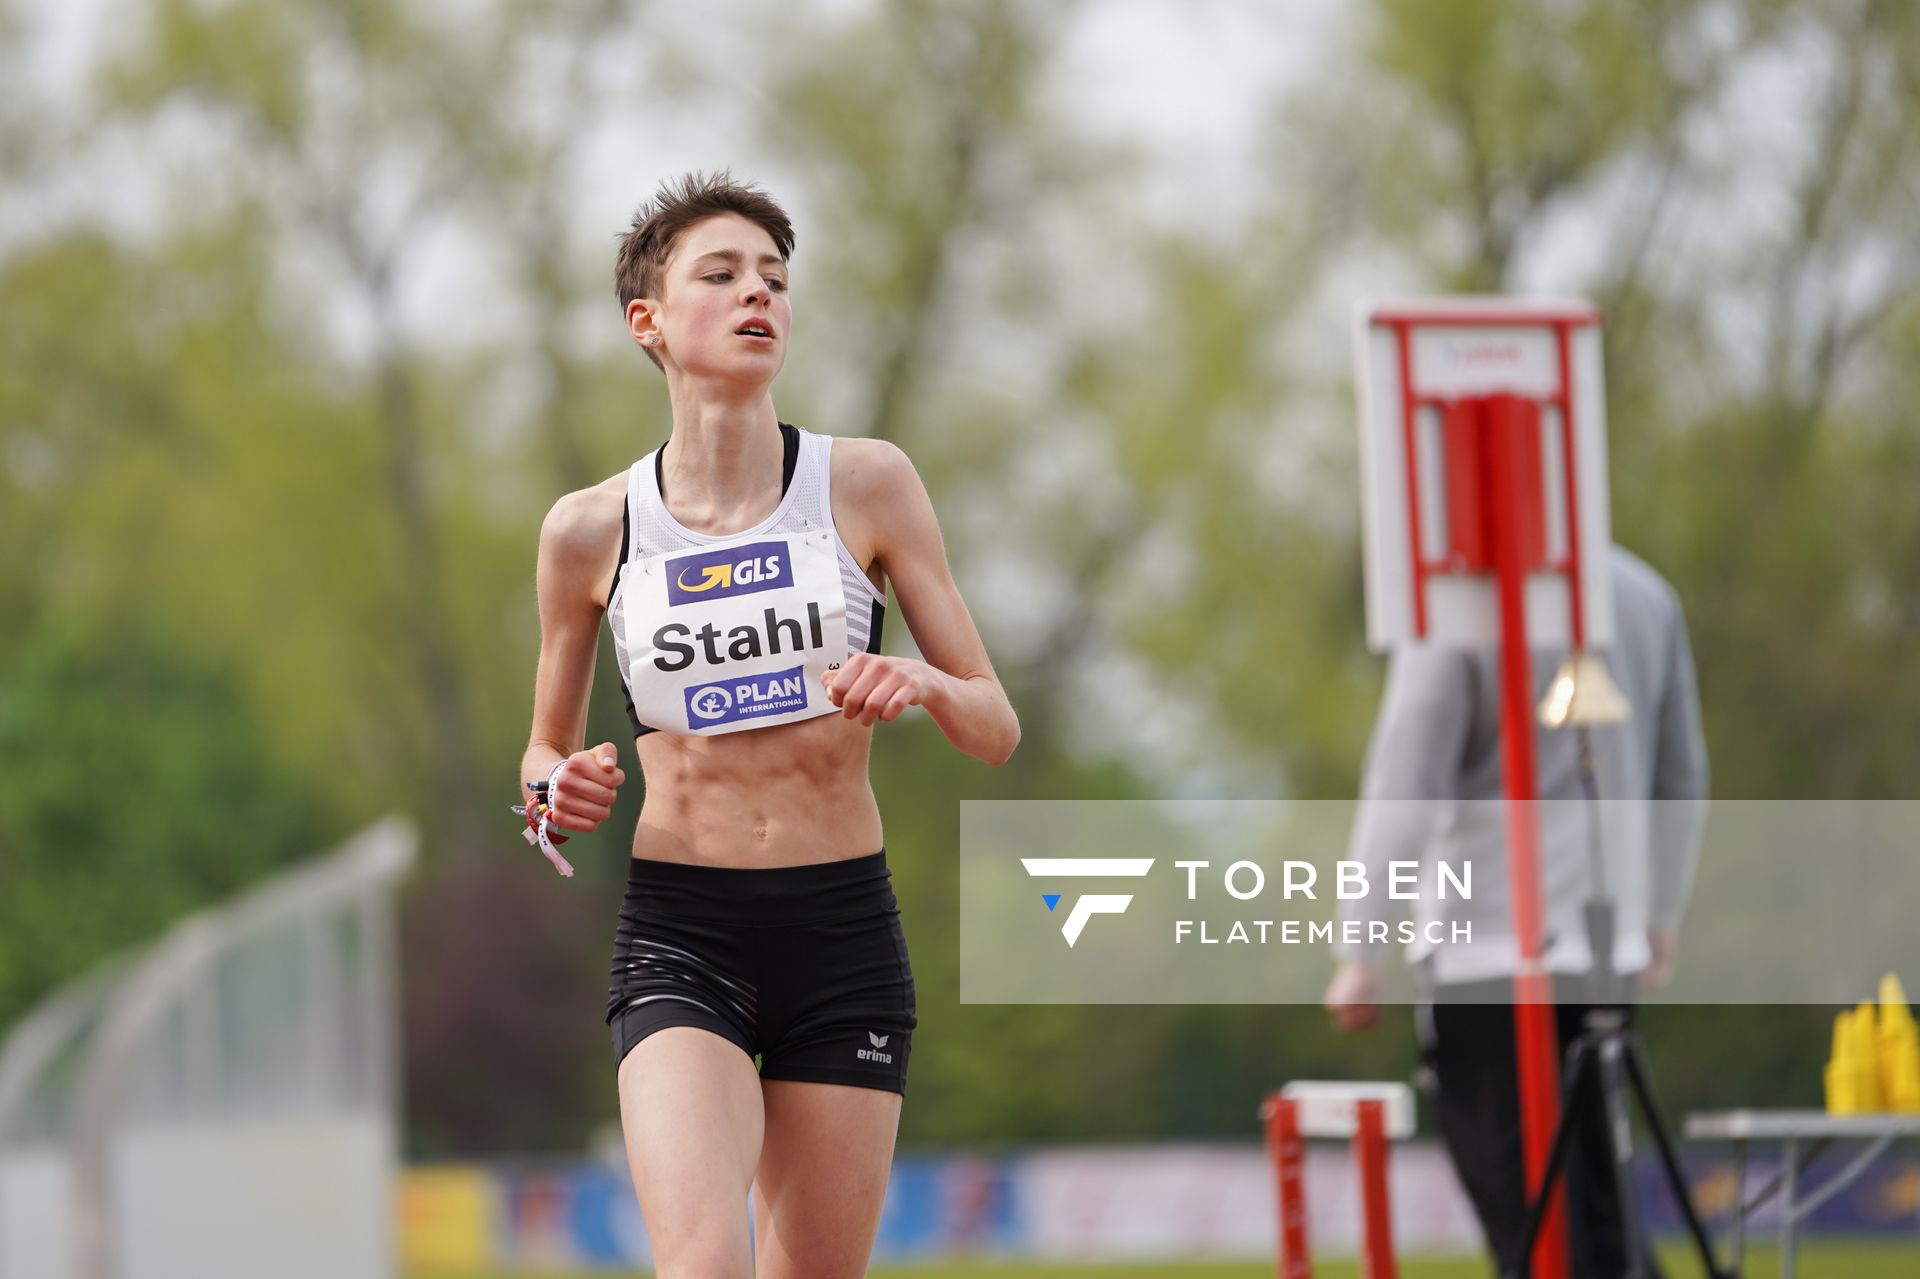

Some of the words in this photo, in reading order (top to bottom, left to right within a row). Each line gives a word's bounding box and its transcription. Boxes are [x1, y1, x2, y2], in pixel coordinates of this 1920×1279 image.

[733, 555, 780, 585] GLS
[652, 602, 823, 672] Stahl
[735, 676, 802, 704] PLAN
[739, 698, 803, 714] INTERNATIONAL
[857, 1048, 892, 1064] erima
